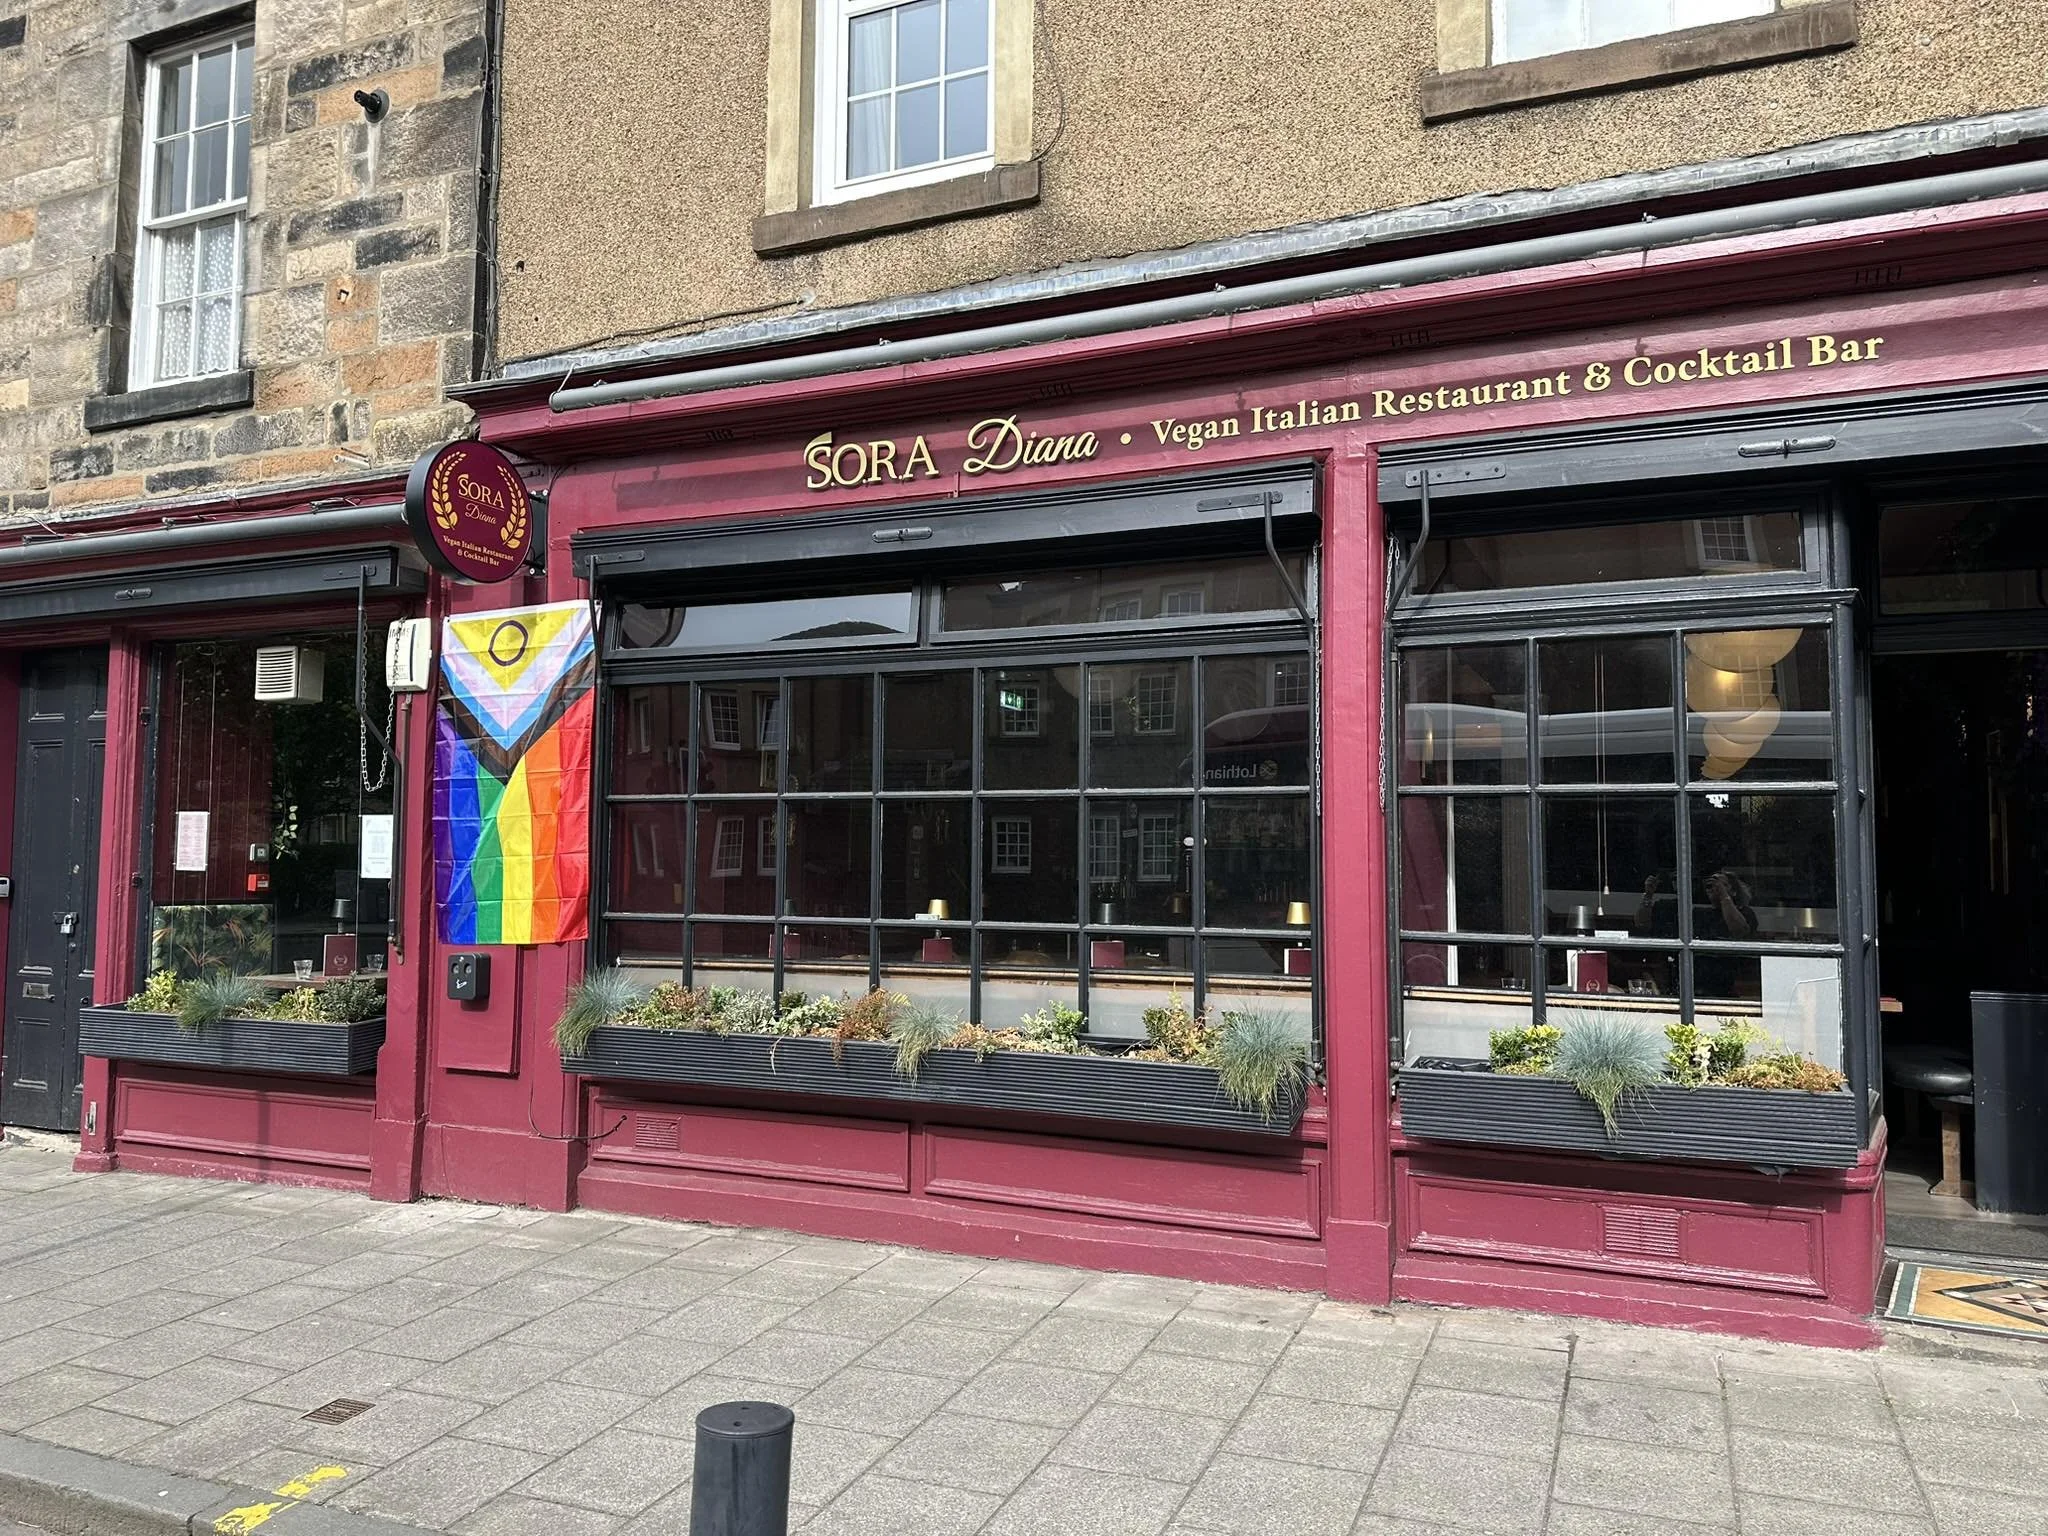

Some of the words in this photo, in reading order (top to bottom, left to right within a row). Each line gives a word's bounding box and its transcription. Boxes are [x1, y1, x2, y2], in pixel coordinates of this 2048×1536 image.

[963, 414, 1098, 473] Diana
[1150, 416, 1241, 450] Vegan
[1250, 400, 1362, 433] Italian
[1371, 369, 1572, 418] Restaurant
[1583, 362, 1612, 391] &
[1622, 339, 1793, 387] Cocktail
[1806, 333, 1884, 366] Bar
[464, 503, 497, 525] Diana
[443, 535, 461, 547] Vegan
[461, 540, 482, 552] Italian
[482, 546, 514, 561] Restaurant
[463, 550, 489, 563] Cocktail
[489, 557, 500, 566] Bar
